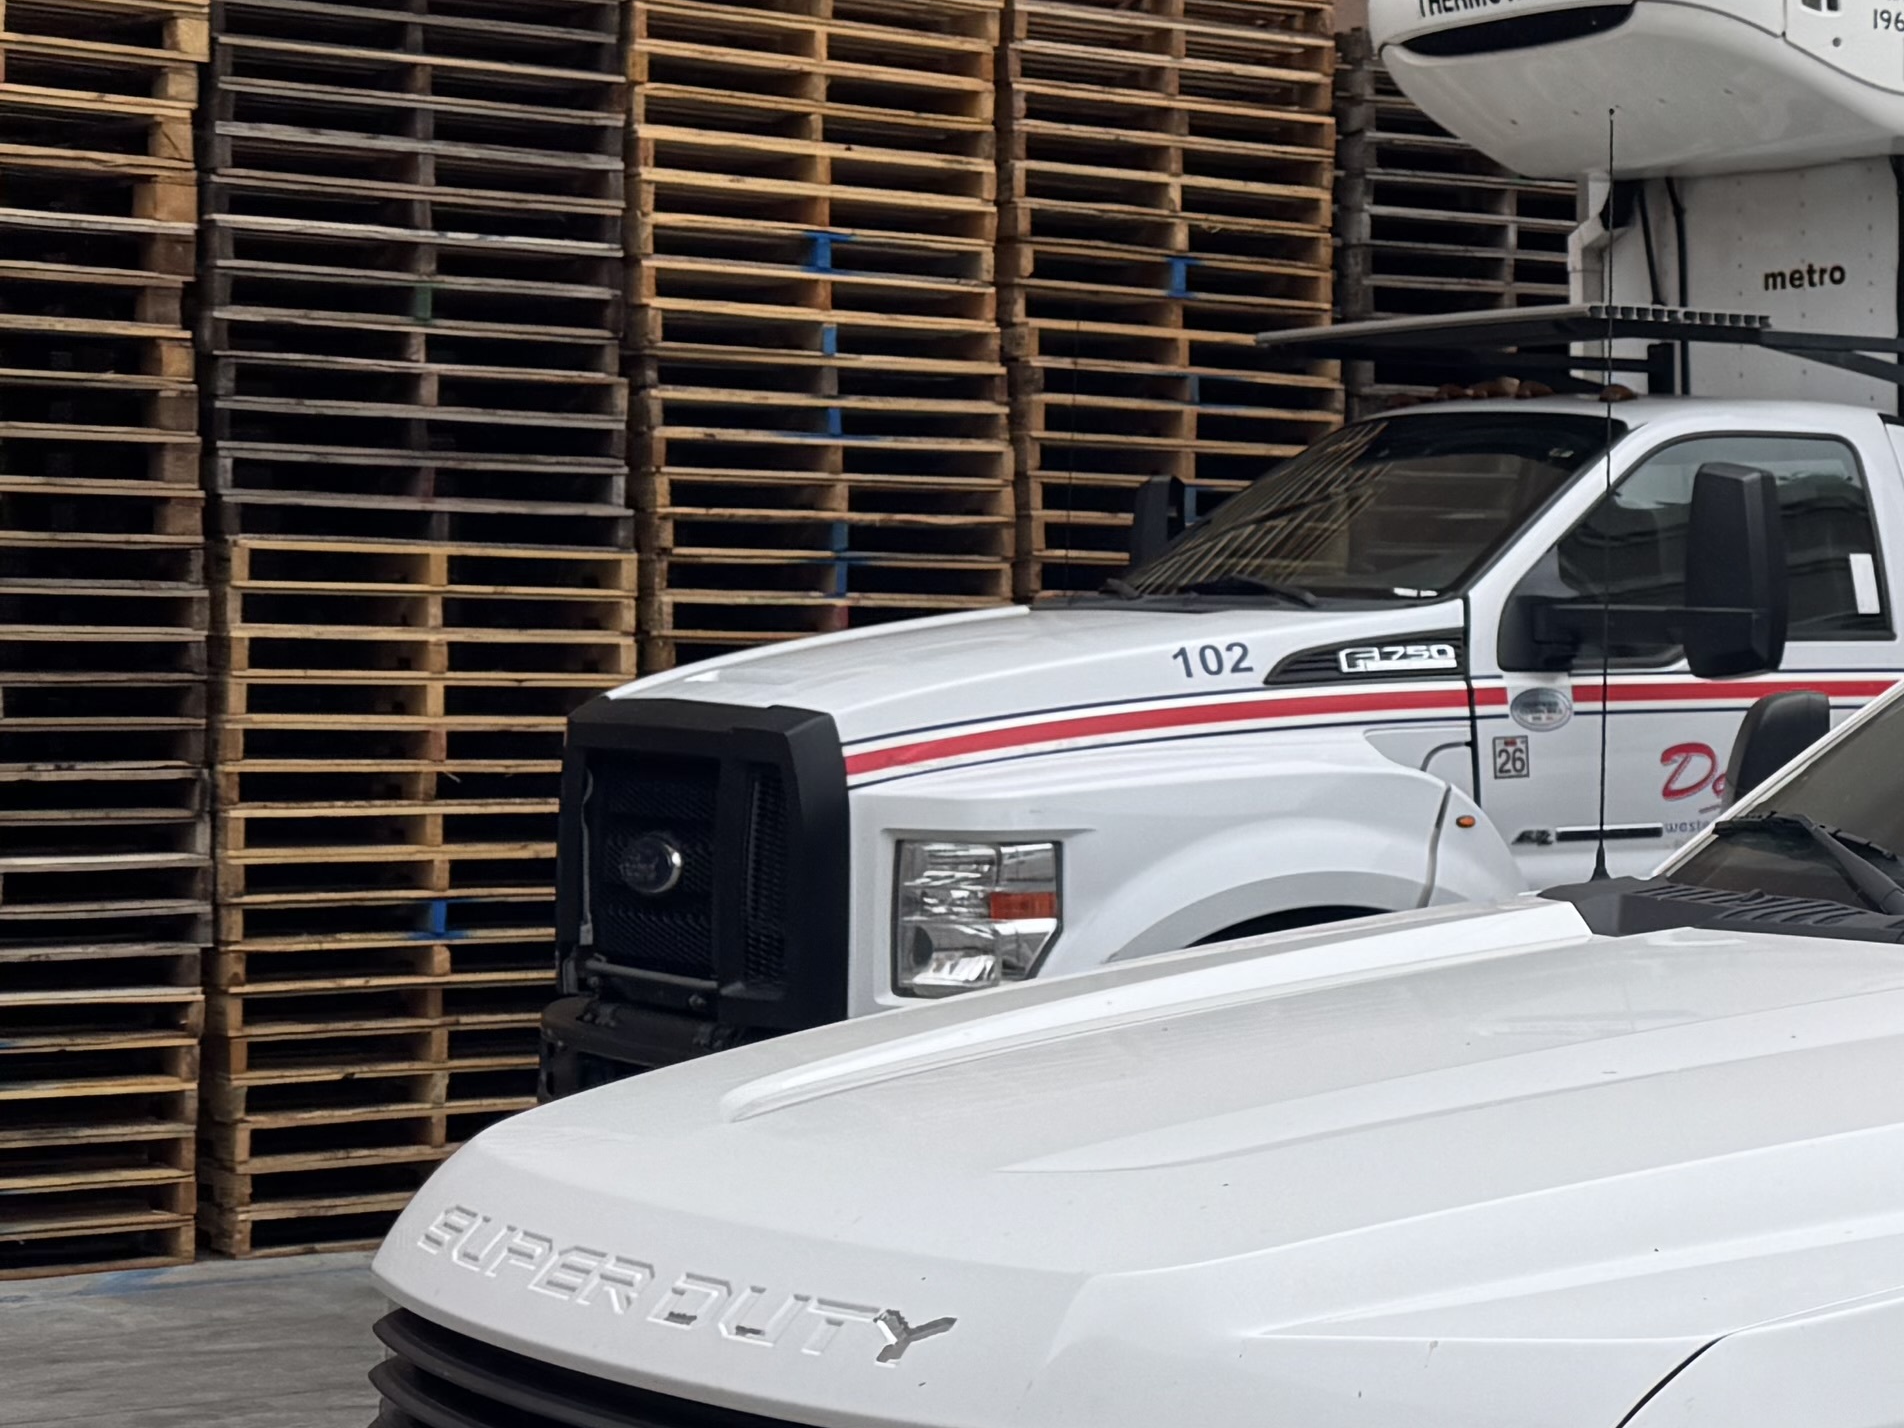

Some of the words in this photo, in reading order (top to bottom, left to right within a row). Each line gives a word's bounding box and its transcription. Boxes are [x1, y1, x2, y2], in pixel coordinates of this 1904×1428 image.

[1764, 263, 1845, 291] metro
[1172, 642, 1254, 678] 102
[1497, 747, 1526, 774] 26
[418, 1204, 656, 1316] SUPER
[647, 1272, 958, 1367] DUTY
